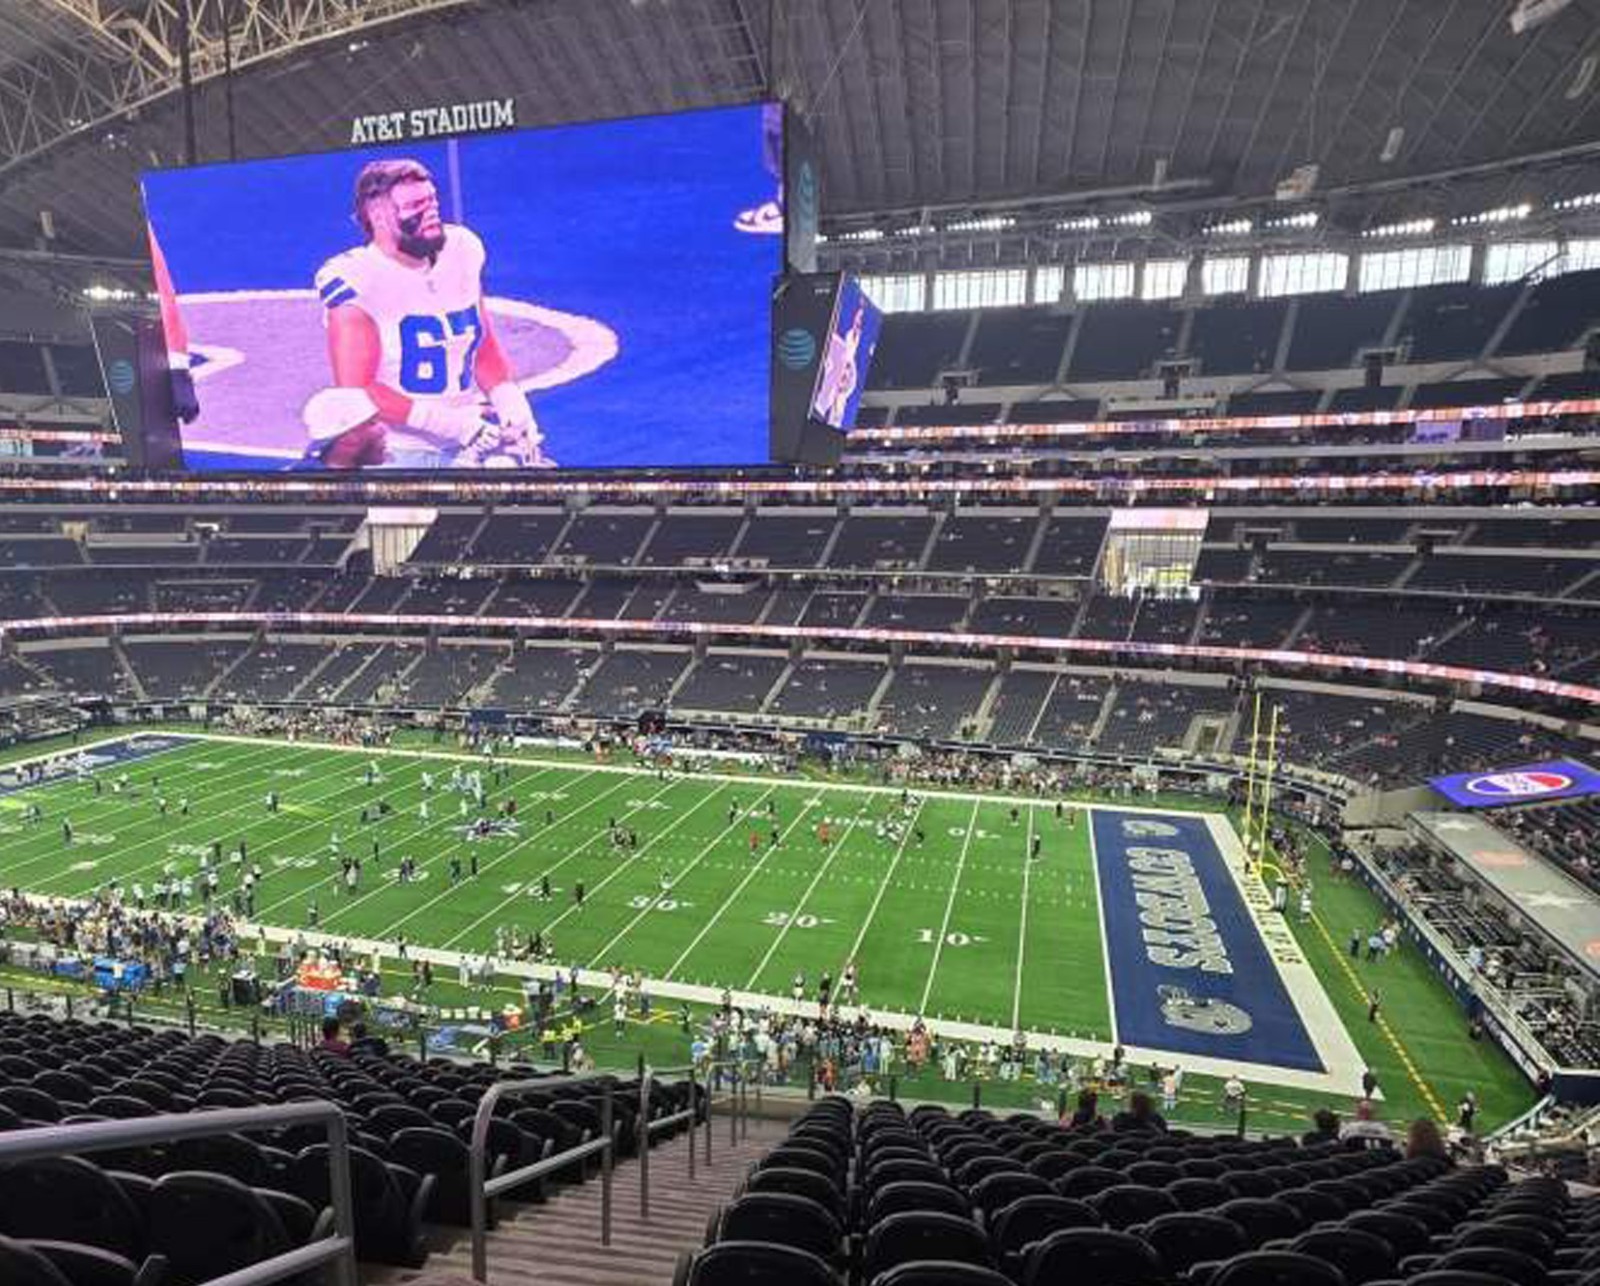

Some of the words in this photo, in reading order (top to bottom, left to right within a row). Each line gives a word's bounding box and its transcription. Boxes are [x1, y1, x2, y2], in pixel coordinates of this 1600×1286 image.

[351, 112, 405, 143] AT&T
[411, 99, 514, 138] STADIUM
[399, 304, 482, 394] 67
[915, 928, 971, 946] 10
